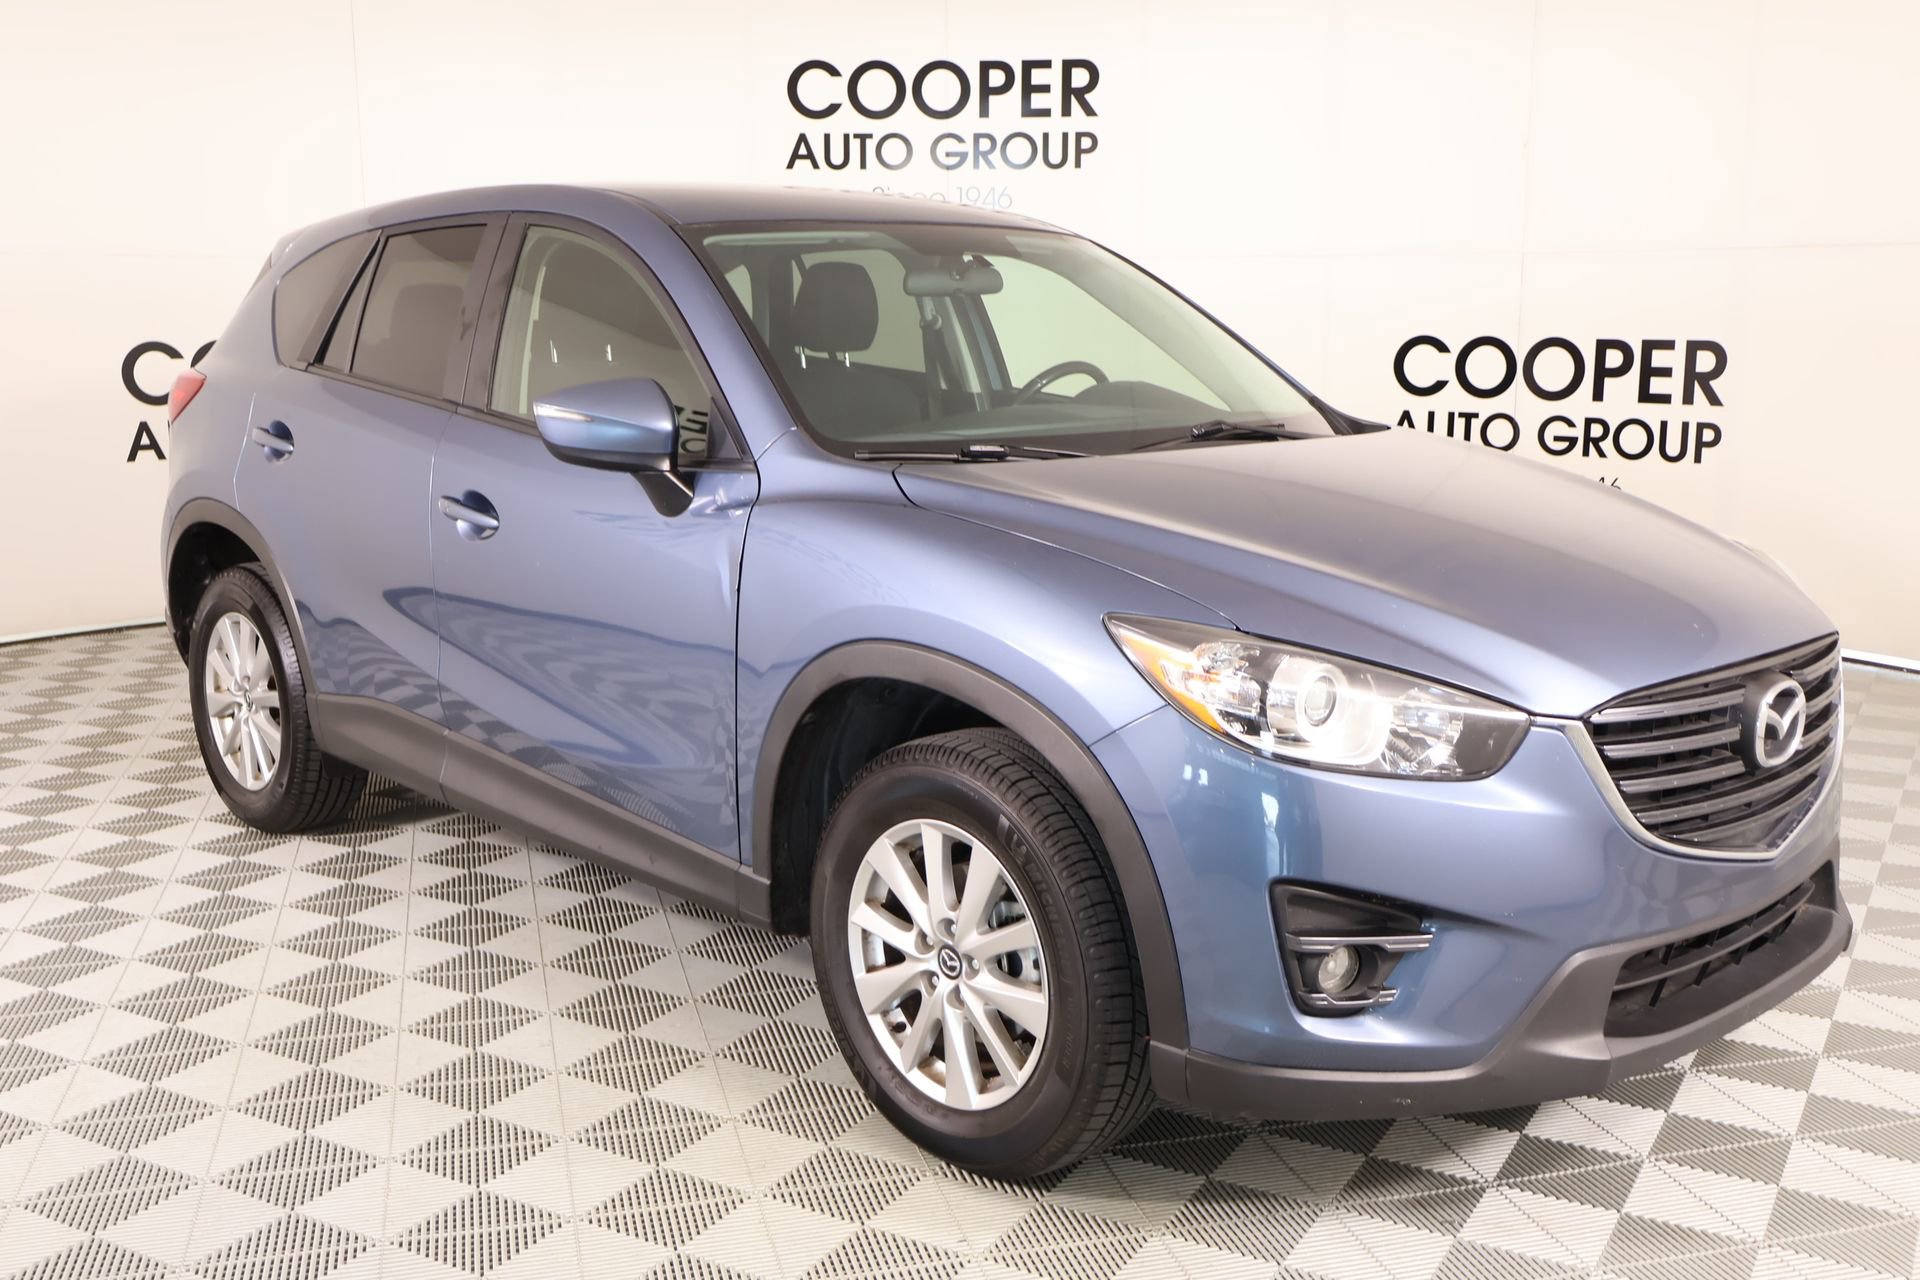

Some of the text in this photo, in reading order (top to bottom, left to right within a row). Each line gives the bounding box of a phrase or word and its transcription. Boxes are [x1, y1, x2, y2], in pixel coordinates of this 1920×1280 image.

[787, 59, 1100, 120] COOPER
[786, 131, 1099, 171] AUTO GROUP
[955, 185, 1013, 210] 1946
[1393, 334, 1728, 407] COOPER
[1537, 414, 1723, 464] GROUP
